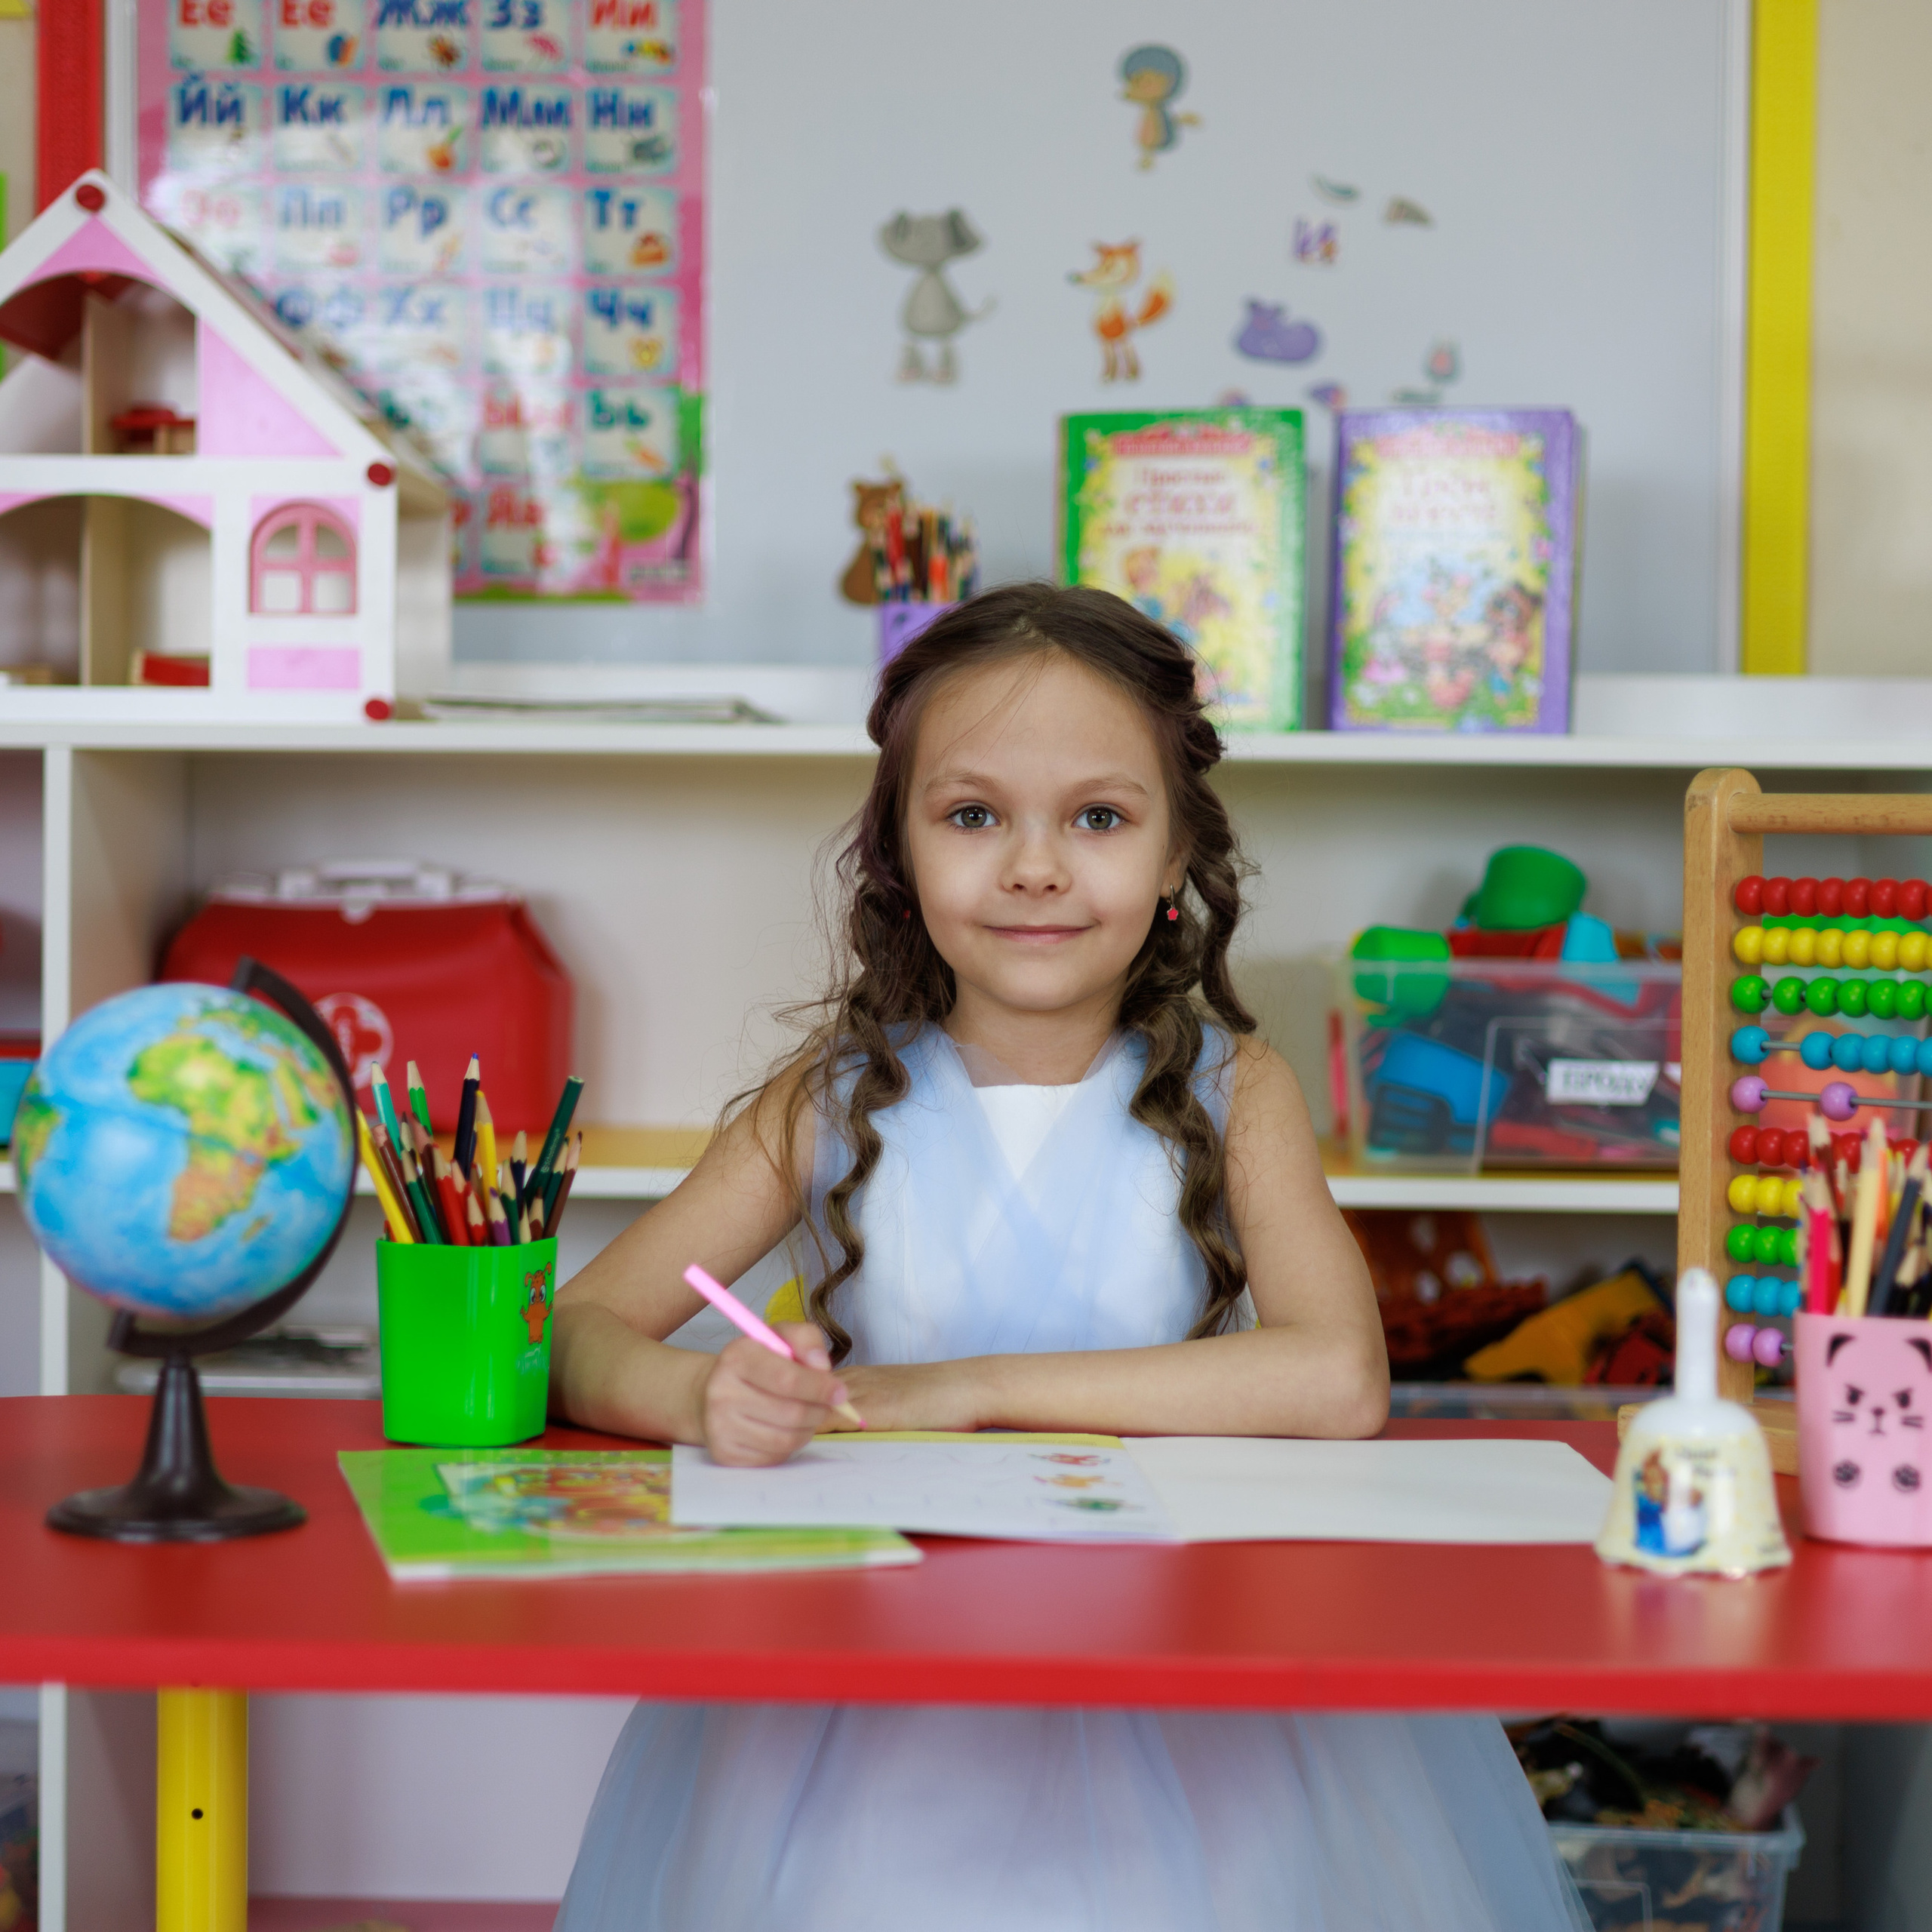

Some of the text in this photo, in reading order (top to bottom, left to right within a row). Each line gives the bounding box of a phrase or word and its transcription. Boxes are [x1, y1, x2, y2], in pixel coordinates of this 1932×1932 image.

[374, 0, 468, 27] Жж
[486, 0, 543, 28] Зз
[590, 0, 655, 28] Ии
[177, 72, 654, 128] Йй Кк Лл Мм Нн
[281, 187, 344, 226] Пп
[386, 187, 448, 240] Рр
[487, 187, 538, 229] Сс
[590, 189, 640, 229] Тт
[383, 286, 447, 326] Хх
[589, 288, 653, 330] Чч
[587, 389, 649, 429] Ьь
